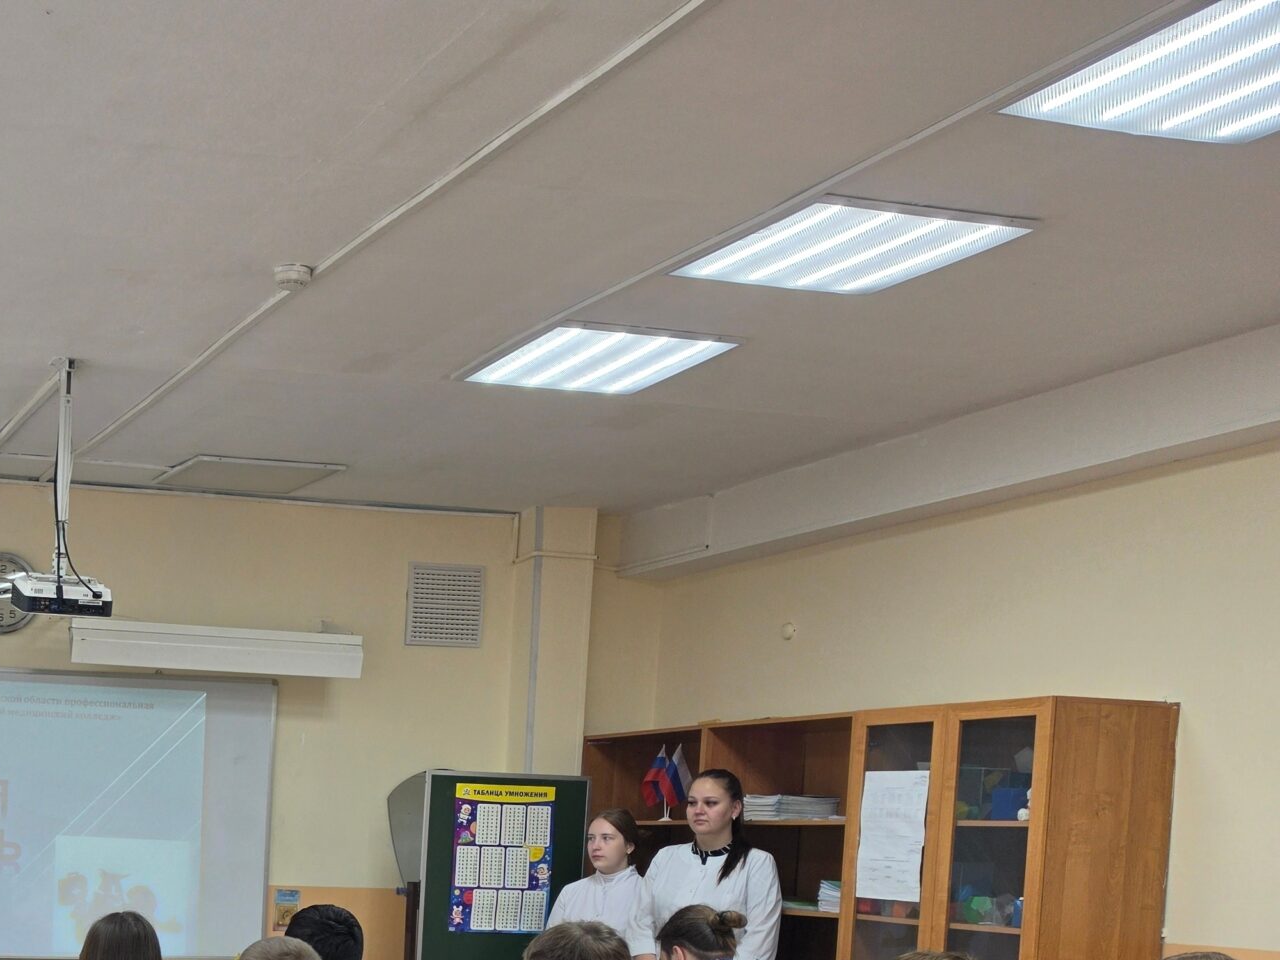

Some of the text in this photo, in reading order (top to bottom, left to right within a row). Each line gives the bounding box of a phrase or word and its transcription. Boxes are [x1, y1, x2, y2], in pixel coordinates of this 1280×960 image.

[9, 609, 16, 619] 5
[473, 789, 548, 798] ТАБЛИЦА УМНОЖЕНИЯ
